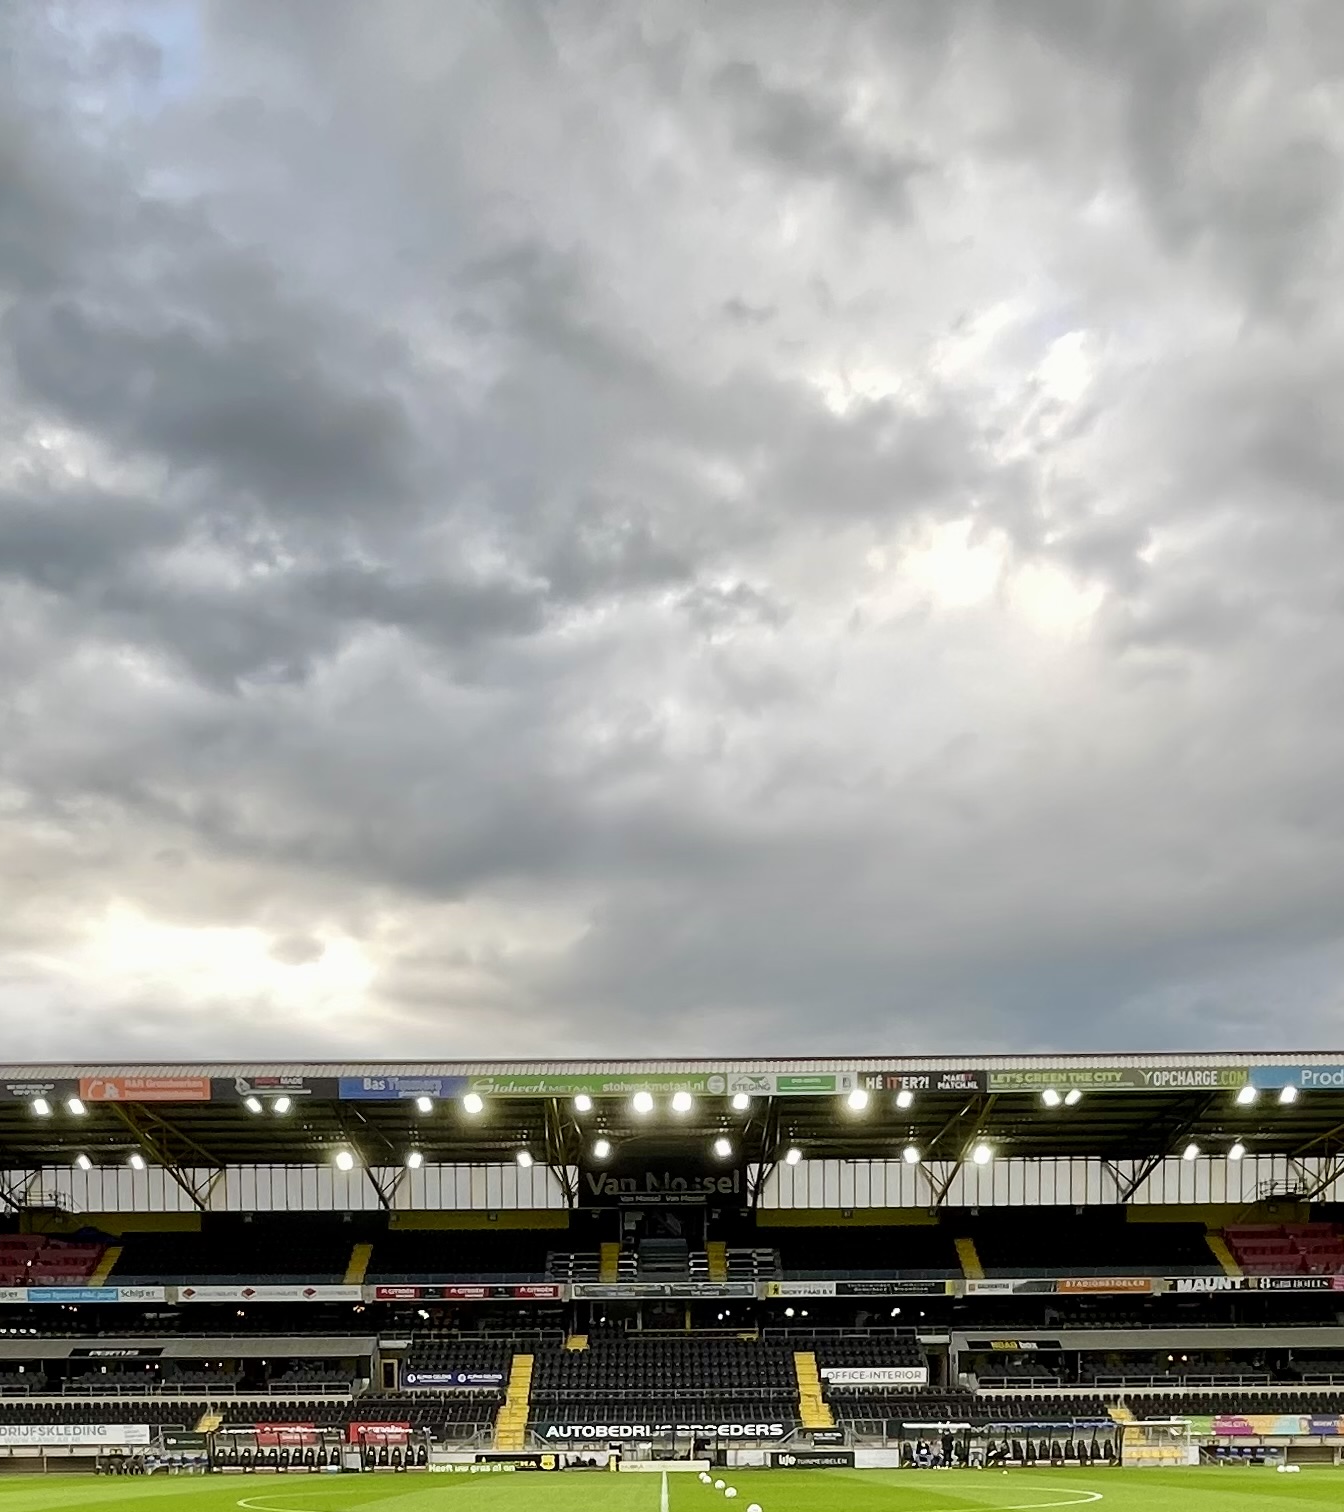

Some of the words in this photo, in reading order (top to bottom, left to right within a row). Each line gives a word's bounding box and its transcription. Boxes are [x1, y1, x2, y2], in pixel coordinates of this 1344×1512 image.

[363, 1077, 386, 1091] Bas
[865, 1073, 884, 1089] HÉ
[989, 1072, 1023, 1085] LET'S
[1023, 1072, 1067, 1084] GREEN
[1068, 1071, 1088, 1084] THE
[1089, 1070, 1123, 1083] CITY
[602, 1080, 705, 1093] stolwerkmetaal.nl
[586, 1172, 636, 1196] Van
[428, 1464, 454, 1473] Heeft
